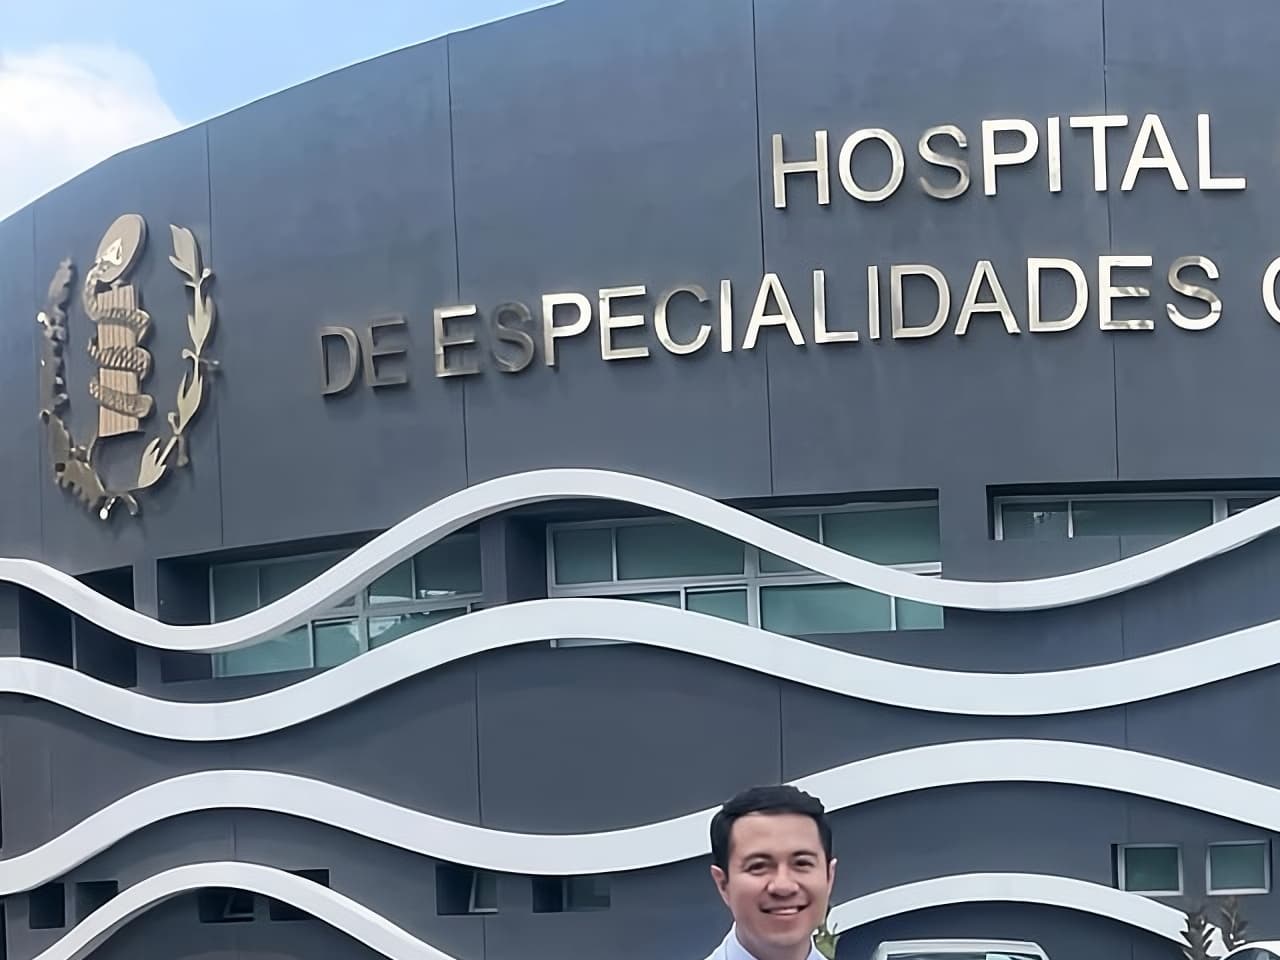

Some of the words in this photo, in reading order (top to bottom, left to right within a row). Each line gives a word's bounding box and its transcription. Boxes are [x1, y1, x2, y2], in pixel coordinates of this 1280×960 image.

[772, 112, 1247, 209] HOSPITAL
[319, 314, 408, 397] DE
[432, 255, 1222, 378] ESPECIALIDADES
